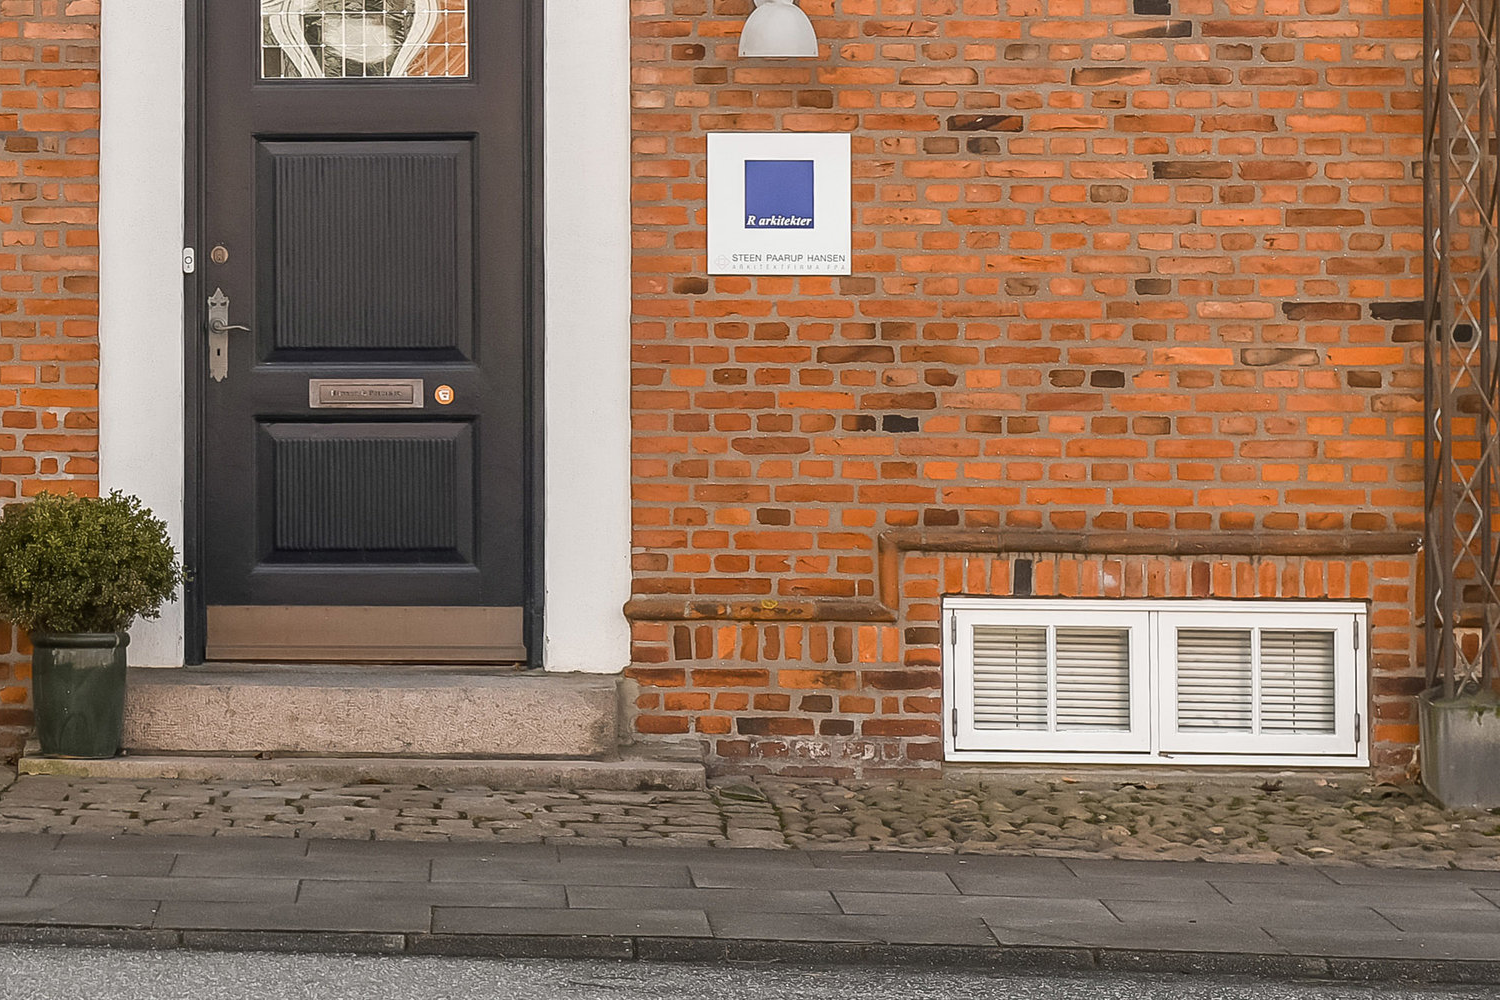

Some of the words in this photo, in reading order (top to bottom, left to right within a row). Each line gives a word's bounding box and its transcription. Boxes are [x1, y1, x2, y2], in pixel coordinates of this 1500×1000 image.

[746, 215, 756, 226] R
[758, 215, 812, 226] arkitekter
[732, 254, 762, 262] STEEN
[766, 254, 803, 262] PAARUP
[807, 254, 846, 262] HANSEN
